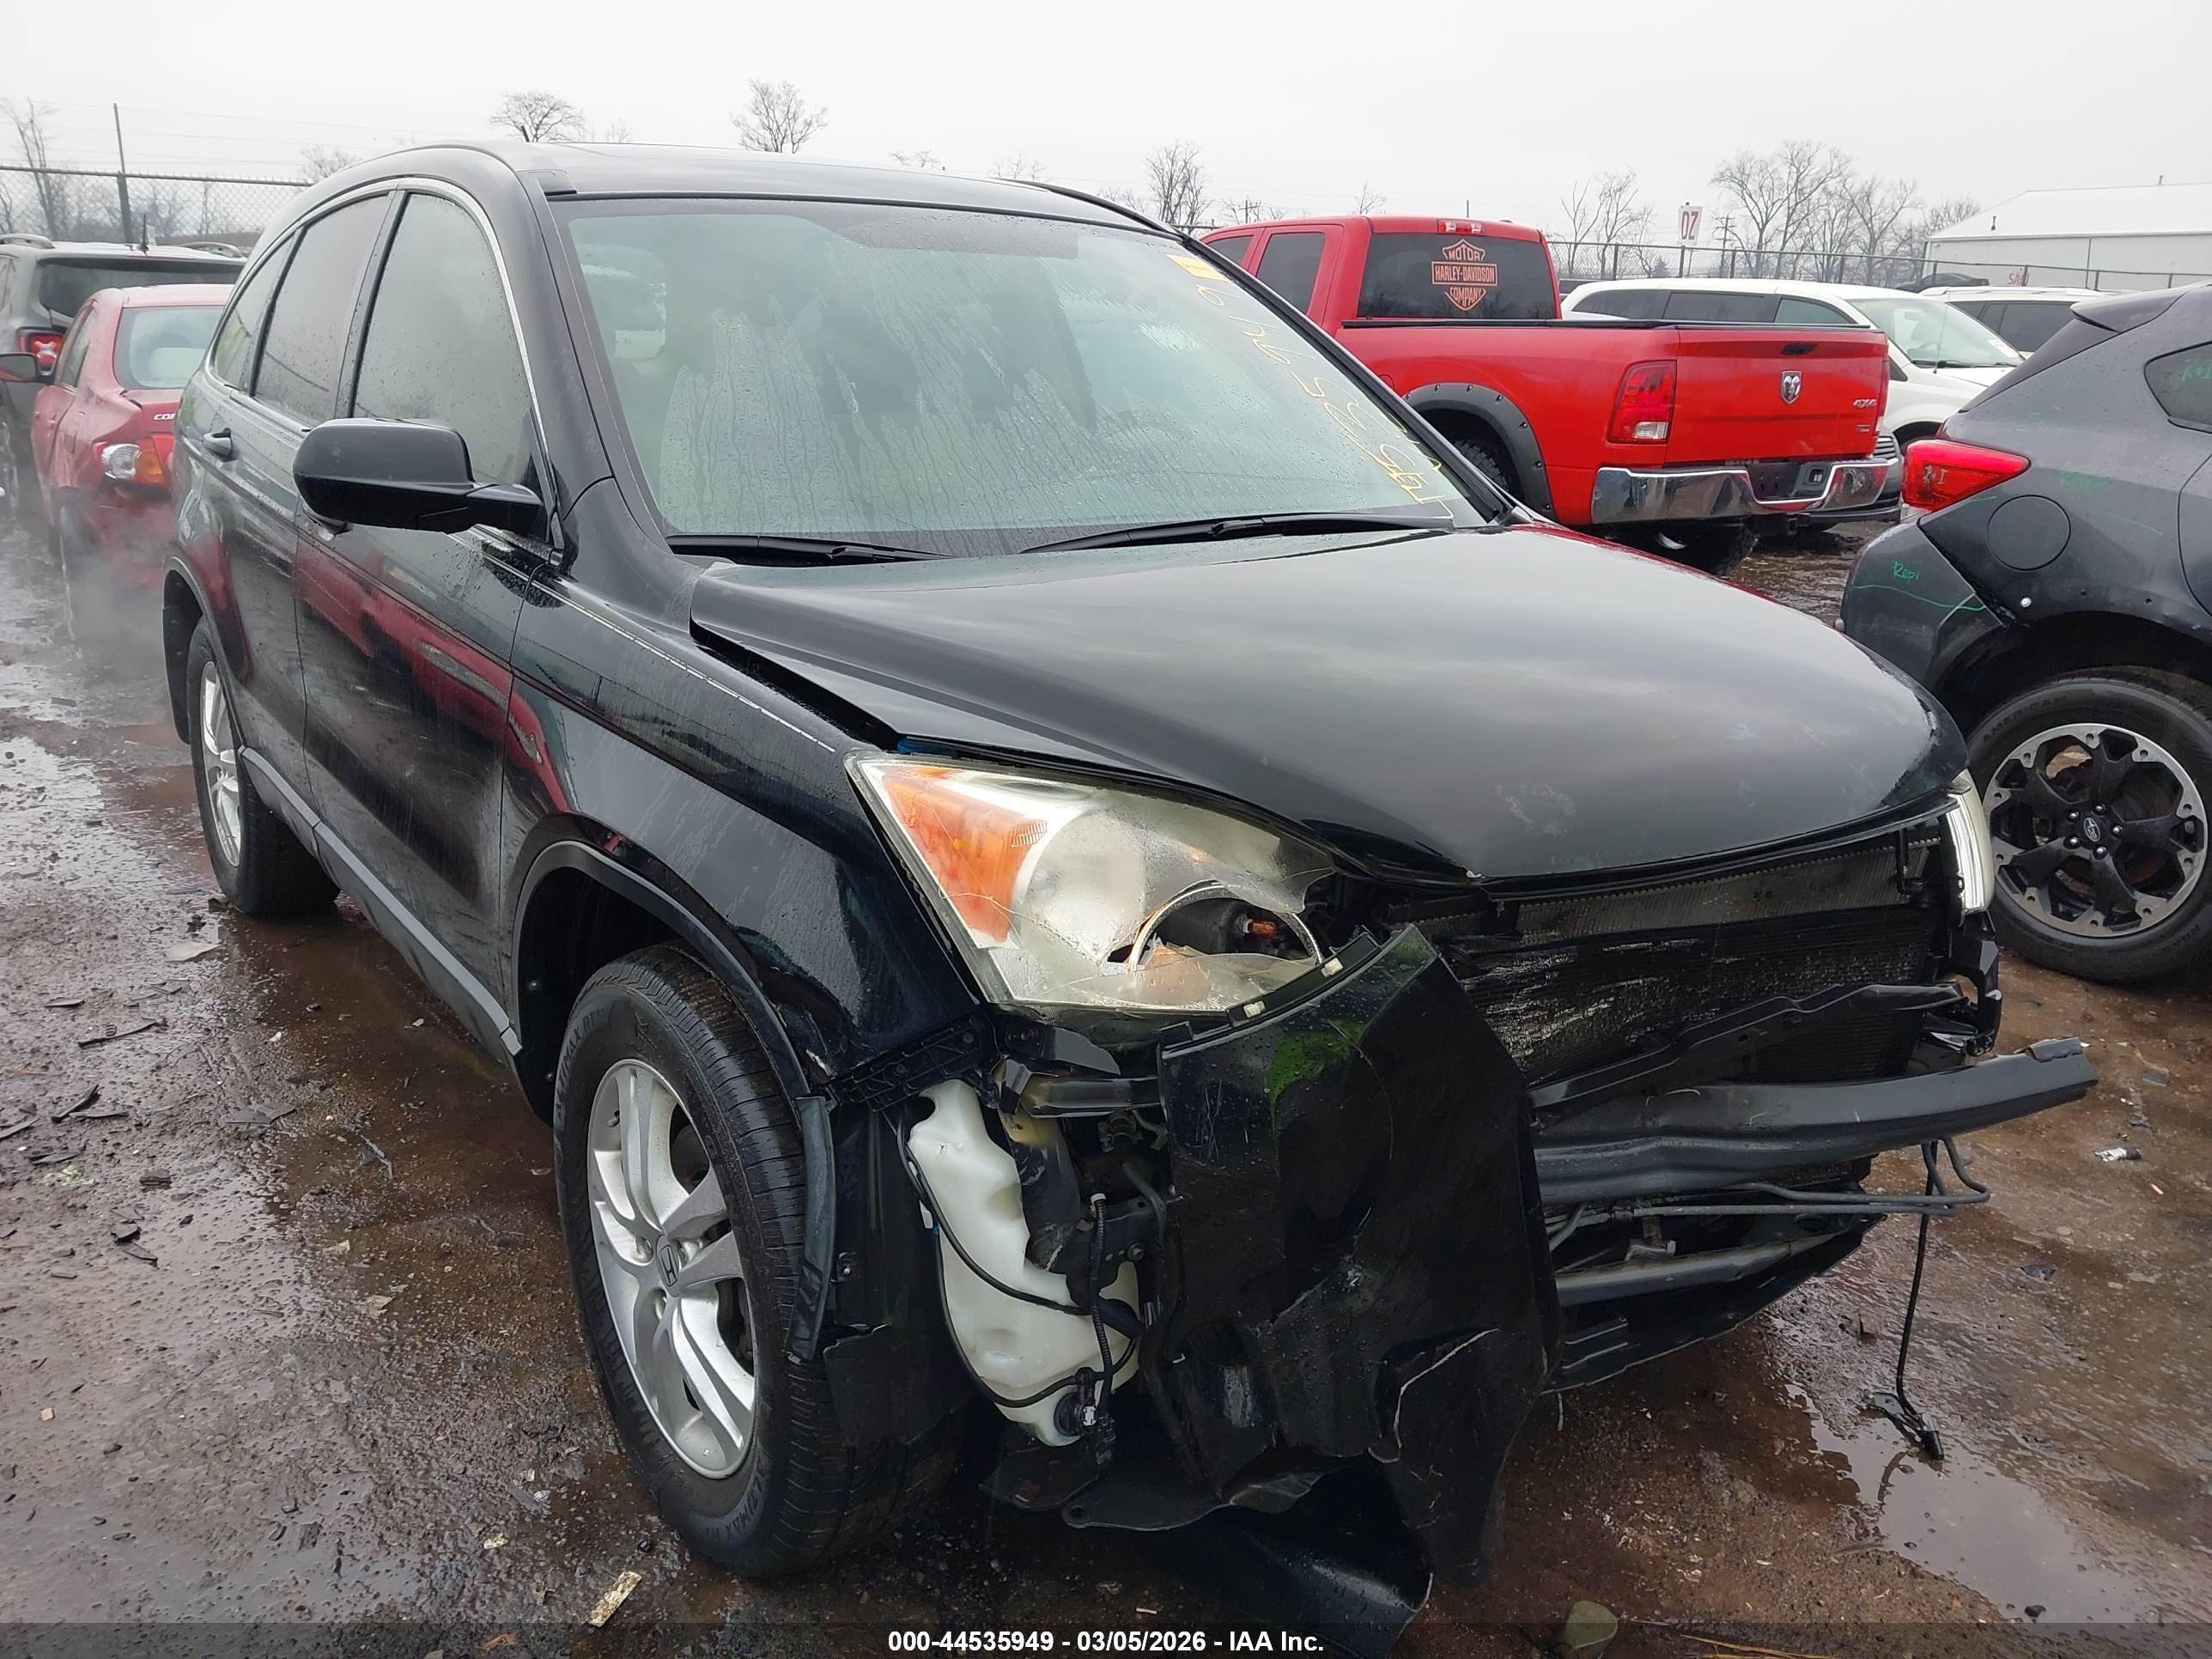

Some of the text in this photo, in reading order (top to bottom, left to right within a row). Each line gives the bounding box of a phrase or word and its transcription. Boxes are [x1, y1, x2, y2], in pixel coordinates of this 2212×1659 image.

[1449, 244, 1480, 261] MOTOR
[1435, 265, 1494, 282] HARLEY-DAVIDSON
[1450, 287, 1481, 307] COMPANY
